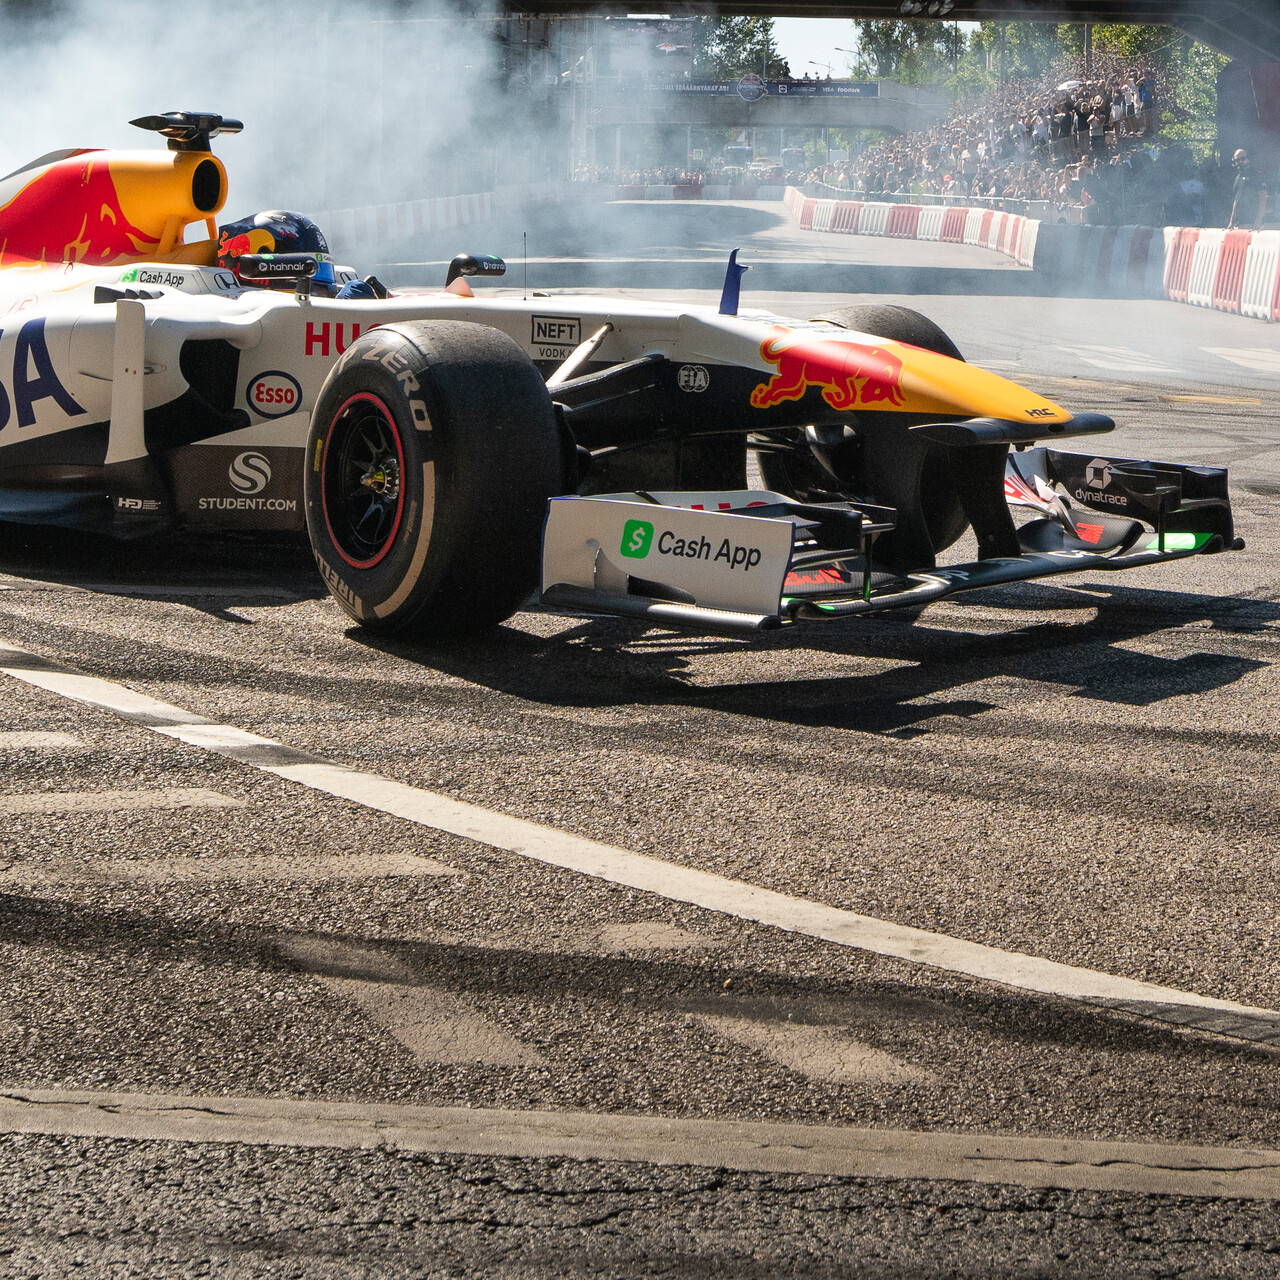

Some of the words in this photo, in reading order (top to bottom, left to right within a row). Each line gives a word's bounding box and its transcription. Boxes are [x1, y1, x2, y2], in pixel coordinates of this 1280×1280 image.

[269, 262, 304, 271] hahnair
[139, 270, 163, 284] Cash
[164, 272, 184, 287] App
[305, 321, 380, 356] HU
[536, 322, 576, 340] NEFT
[198, 497, 296, 512] STUDENT.COM
[1075, 487, 1127, 506] dynatrace
[657, 531, 711, 559] Cash
[714, 538, 762, 572] App
